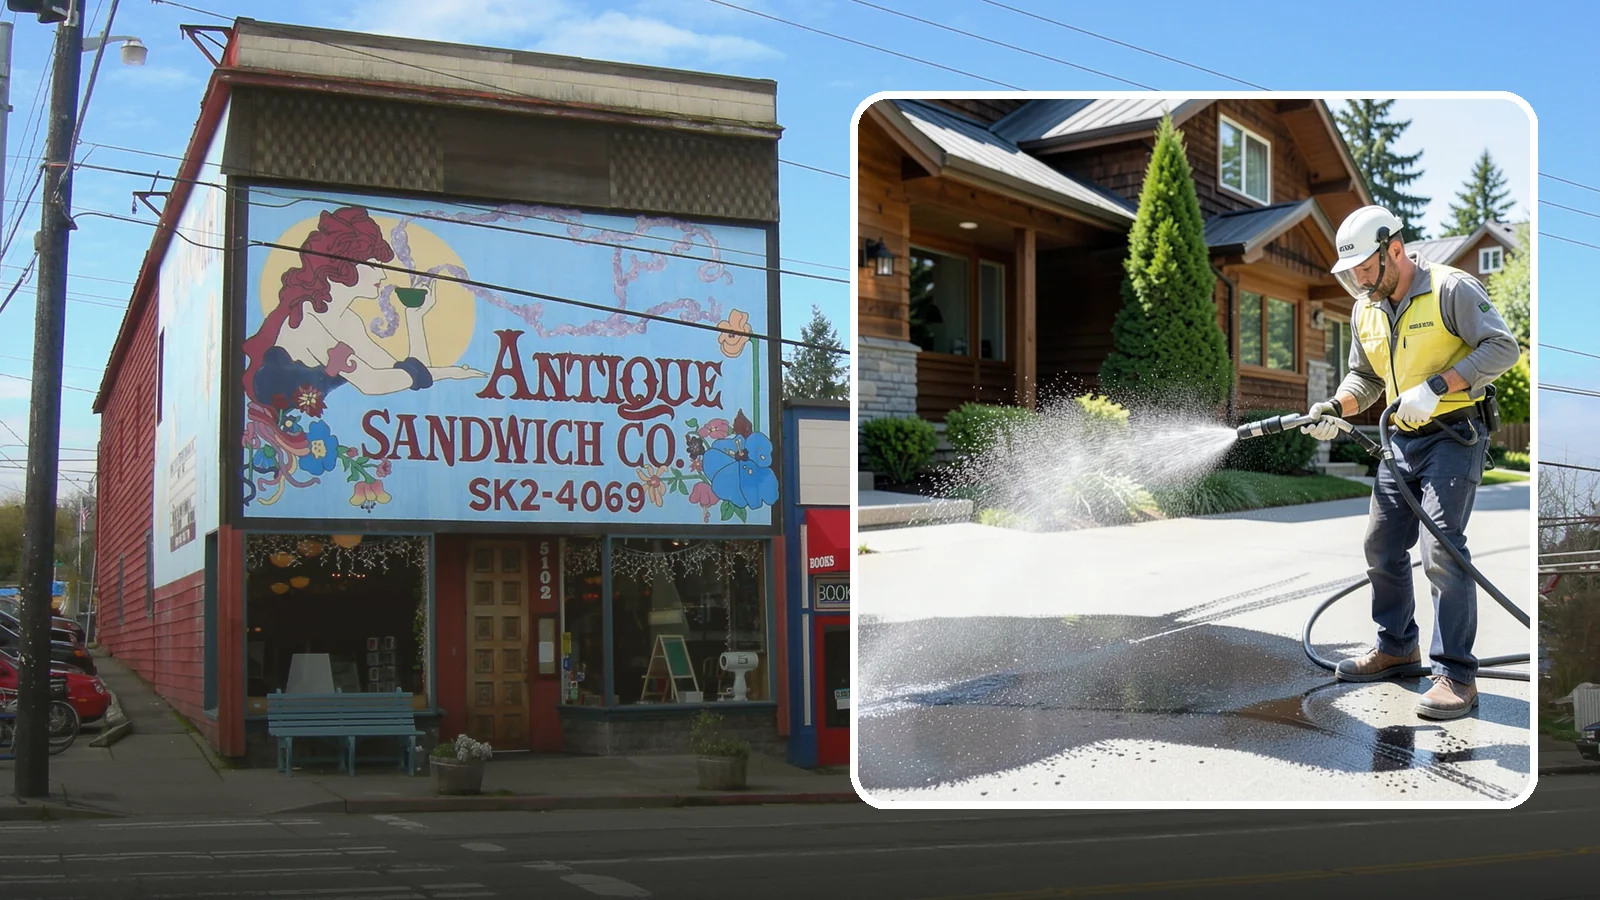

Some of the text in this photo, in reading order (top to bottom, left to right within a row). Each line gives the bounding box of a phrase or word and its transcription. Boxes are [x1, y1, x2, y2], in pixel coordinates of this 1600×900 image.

[476, 329, 723, 421] ANTIQUE
[361, 409, 686, 469] SANDWICH CO.
[468, 477, 646, 512] SK2-4069
[540, 542, 551, 600] 5102
[810, 555, 834, 568] BOOKS
